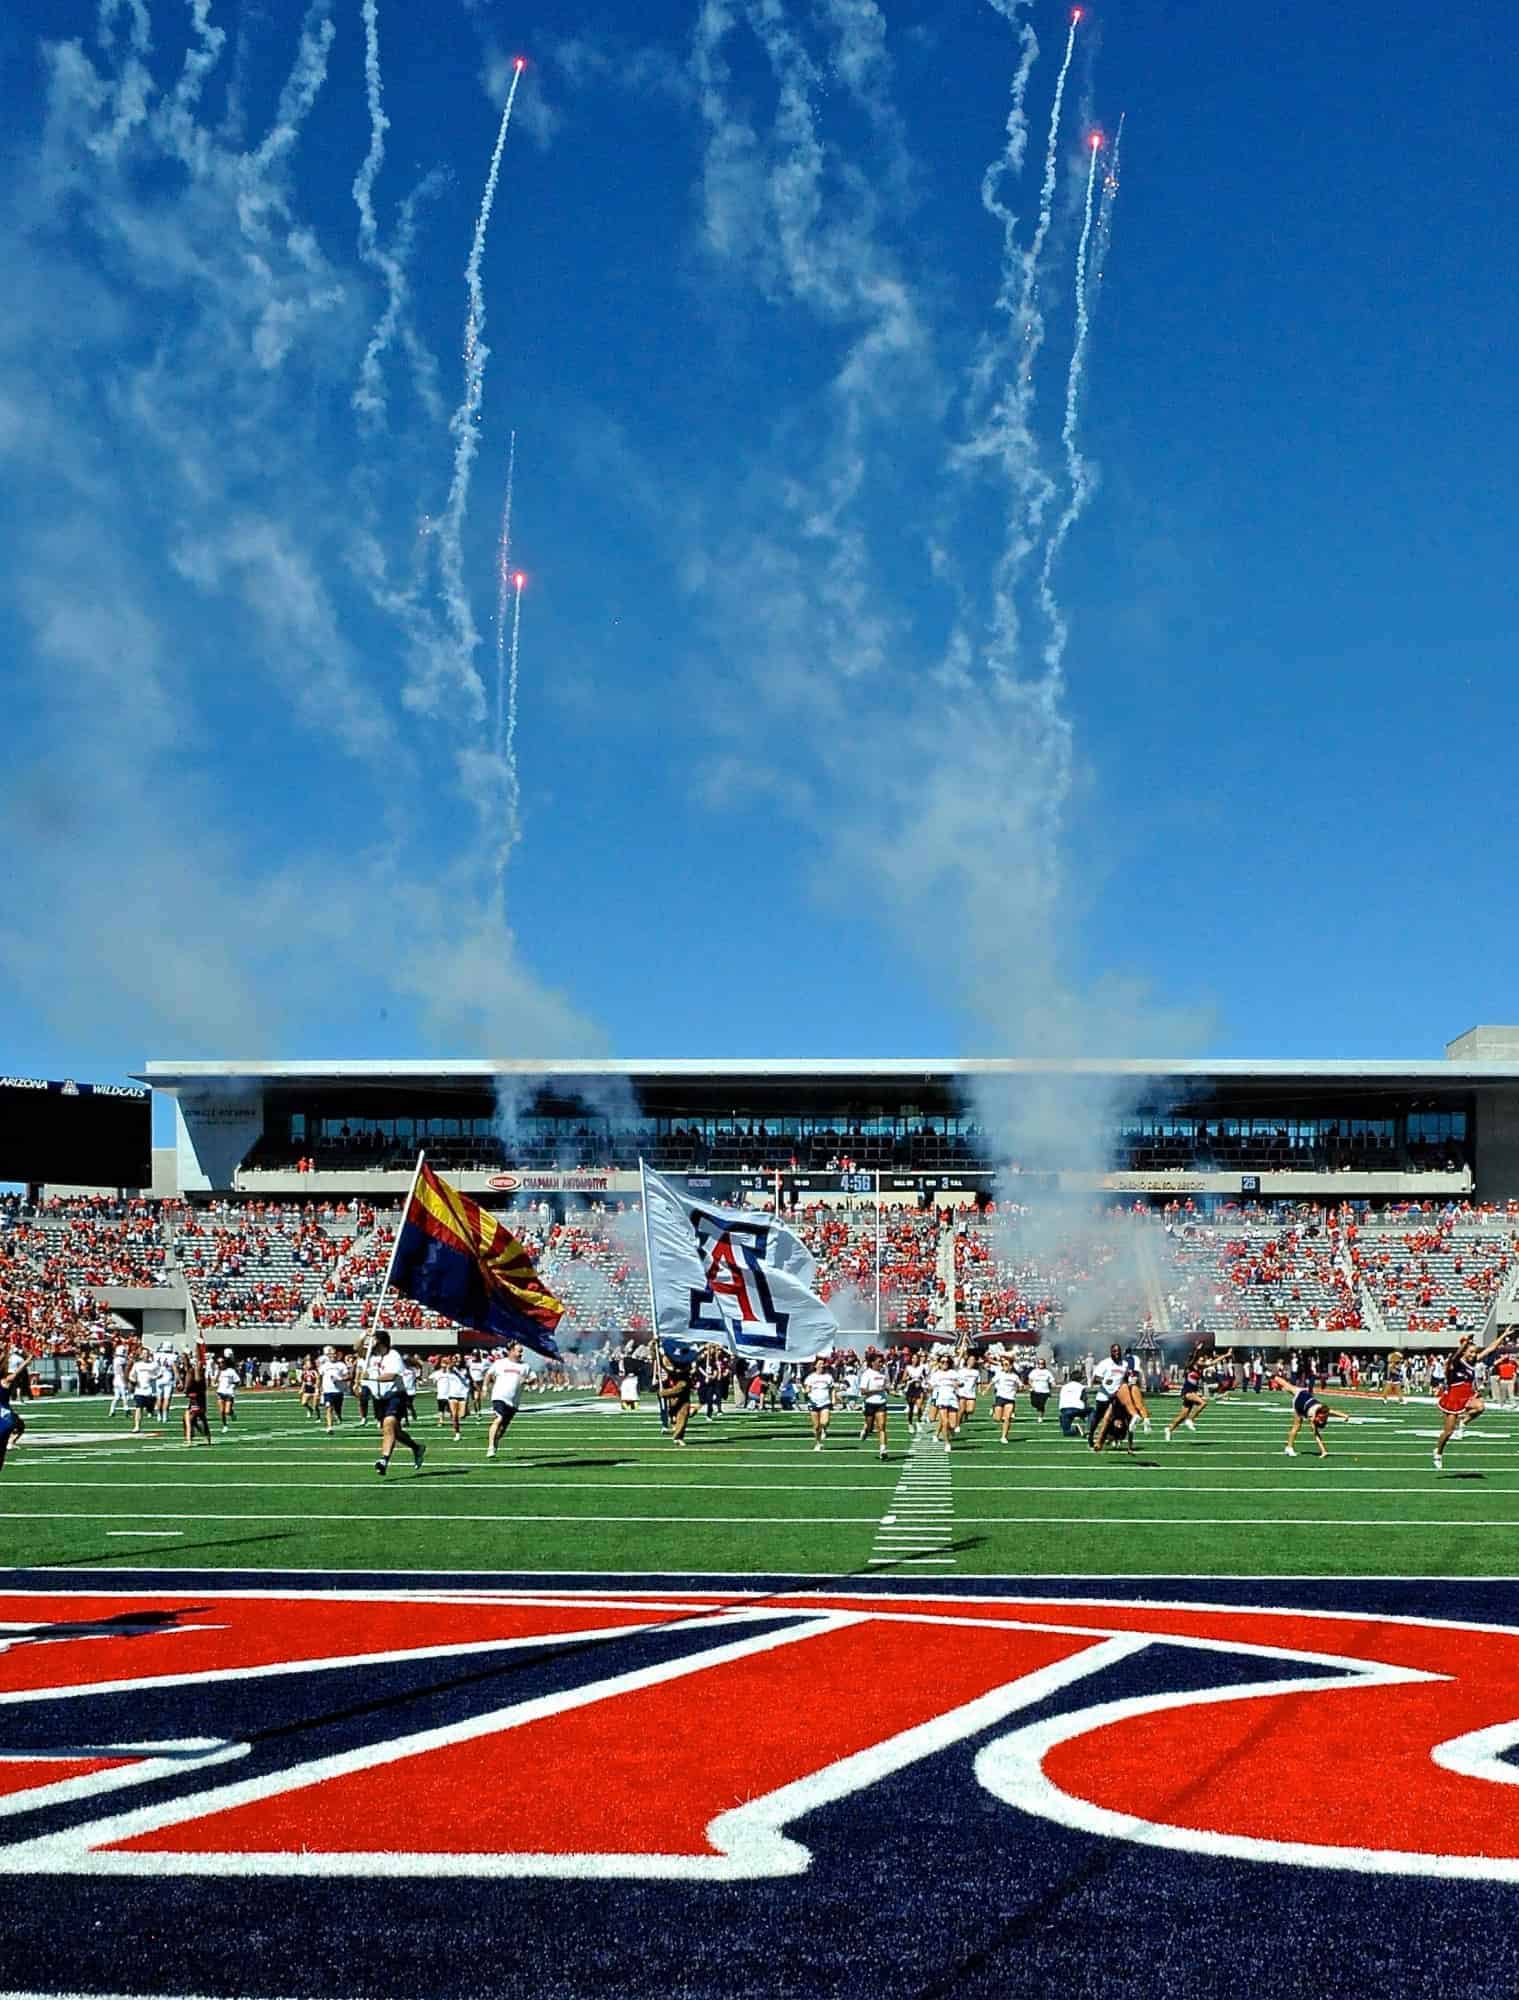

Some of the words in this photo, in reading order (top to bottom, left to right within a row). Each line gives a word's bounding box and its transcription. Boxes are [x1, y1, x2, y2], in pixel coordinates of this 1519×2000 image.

[0, 1076, 48, 1090] ARIZONA
[93, 1084, 145, 1098] WILDCATS
[689, 1208, 790, 1351] A
